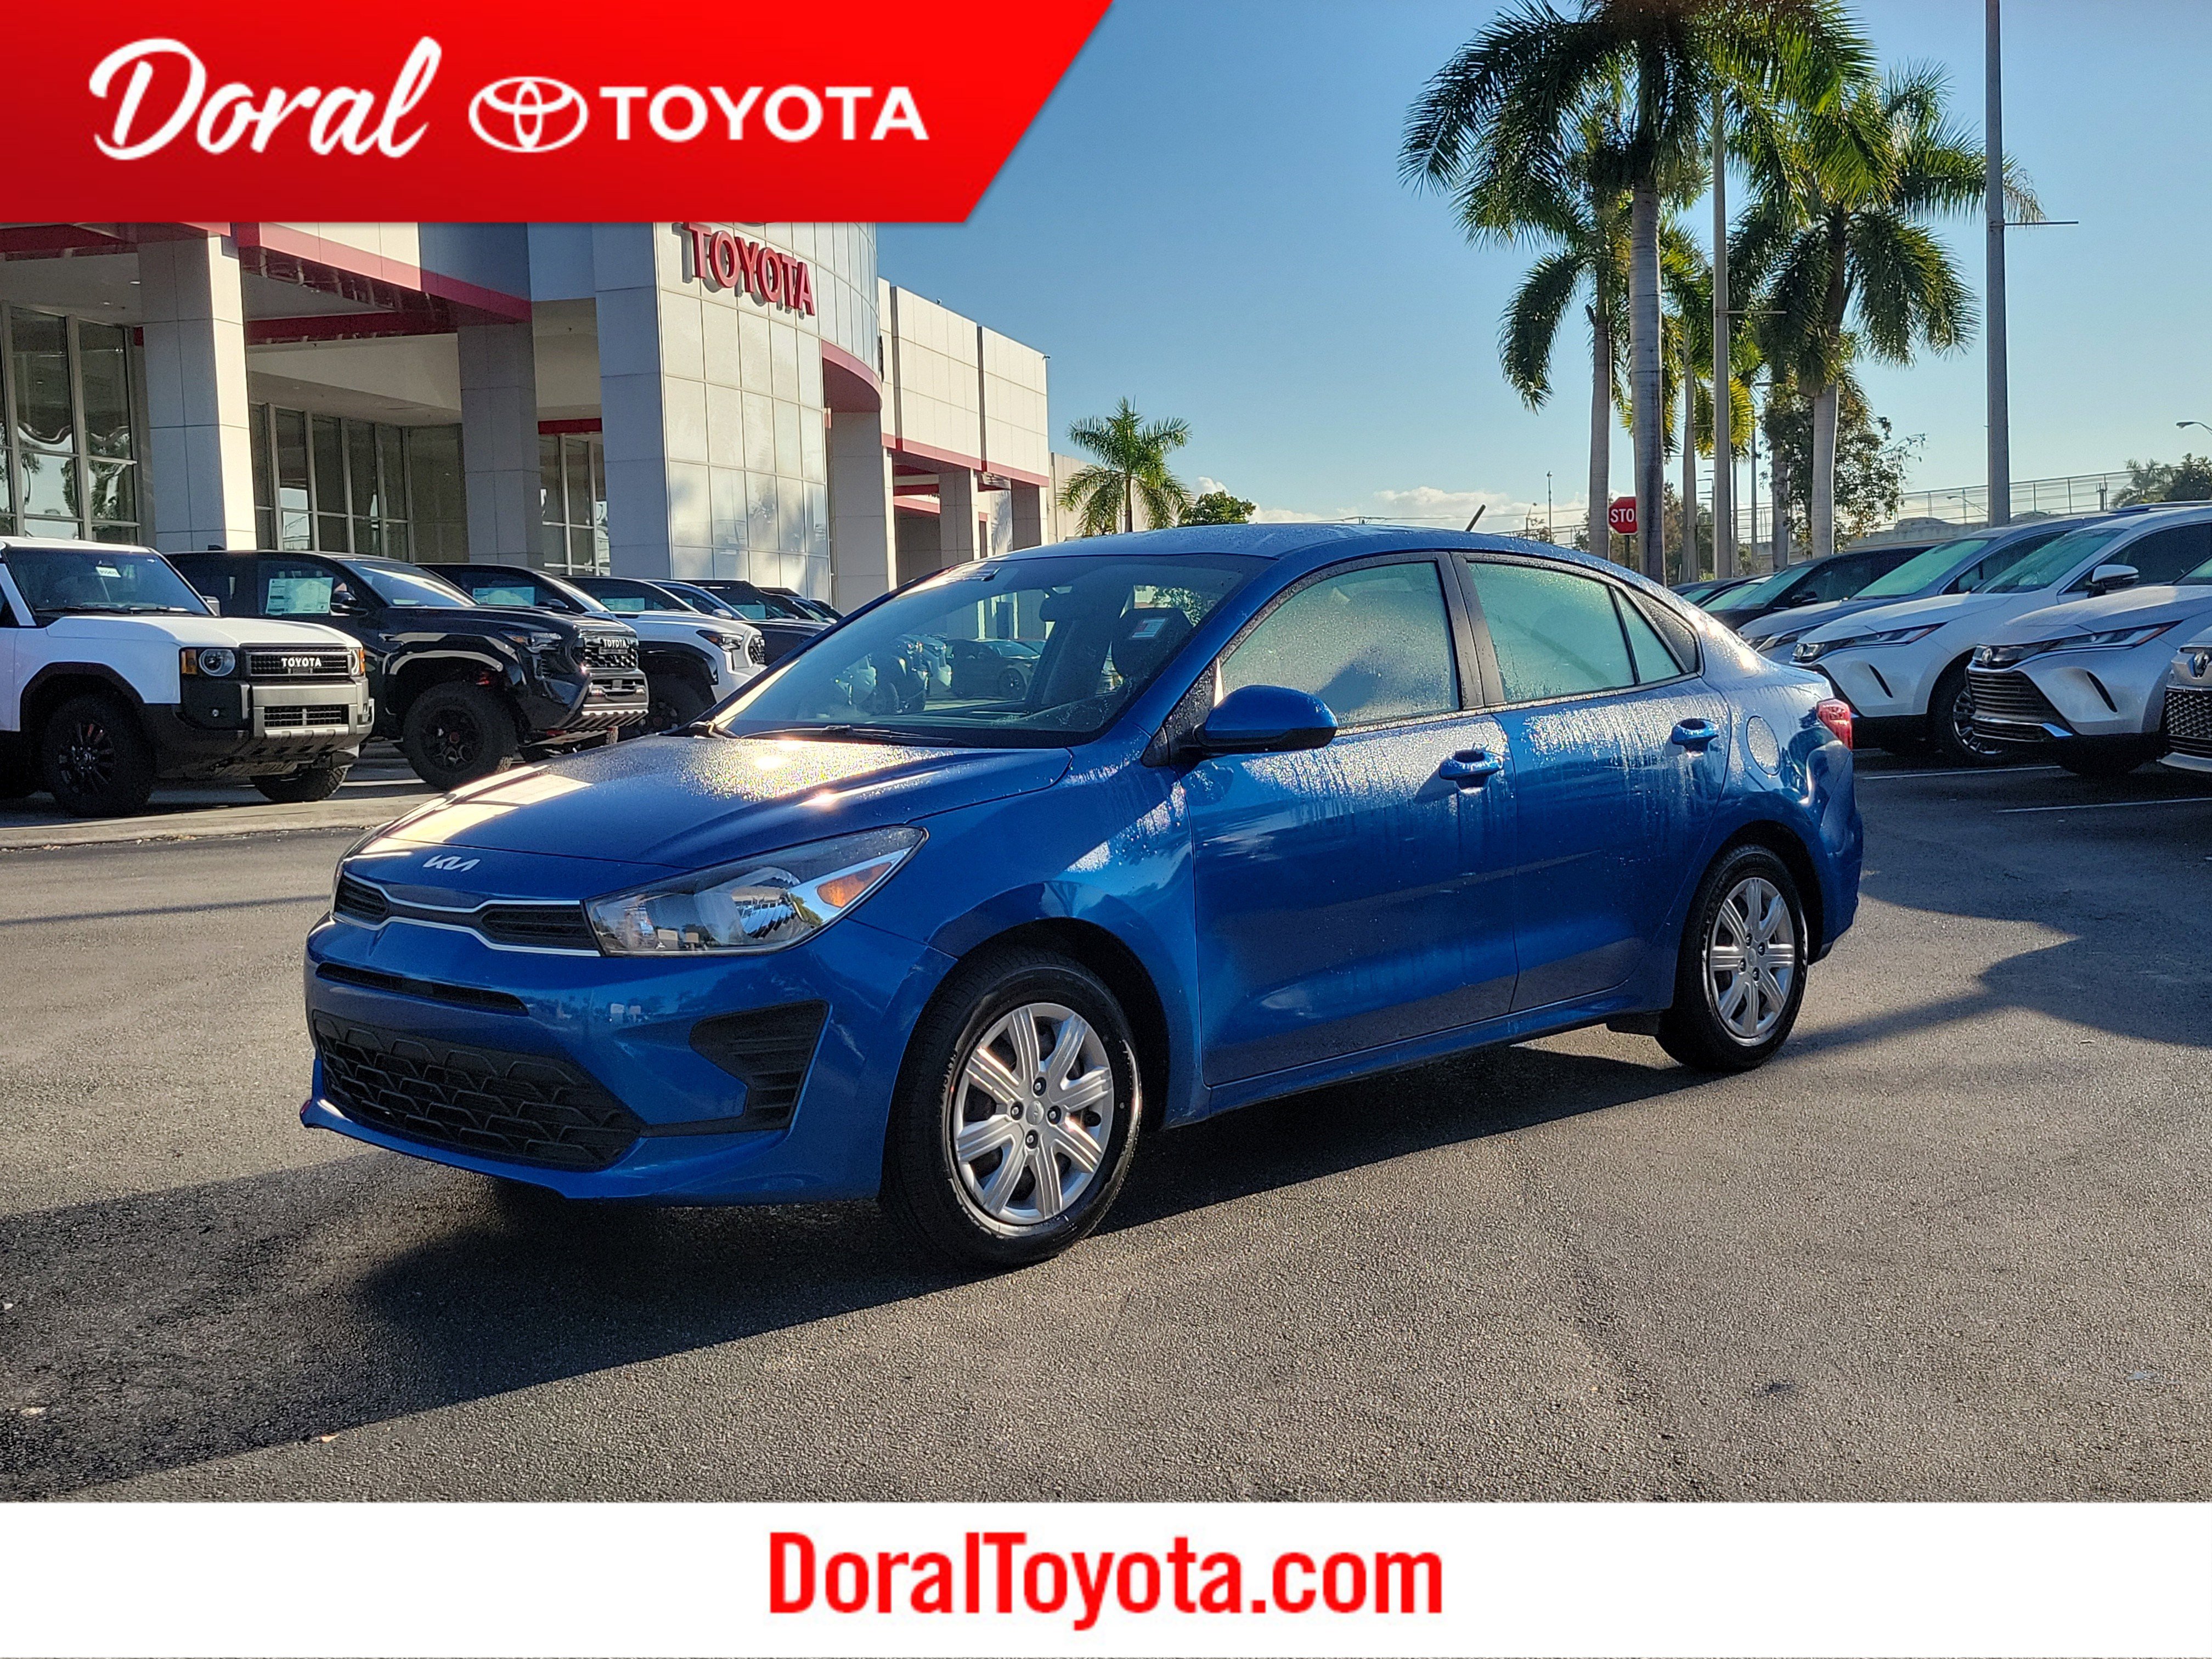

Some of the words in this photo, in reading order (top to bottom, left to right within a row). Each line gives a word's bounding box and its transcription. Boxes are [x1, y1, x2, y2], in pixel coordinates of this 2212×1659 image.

[683, 222, 815, 316] TOYOTA
[1610, 508, 1635, 523] STO
[603, 639, 627, 648] TOYOTA
[281, 657, 322, 667] TOYOTA
